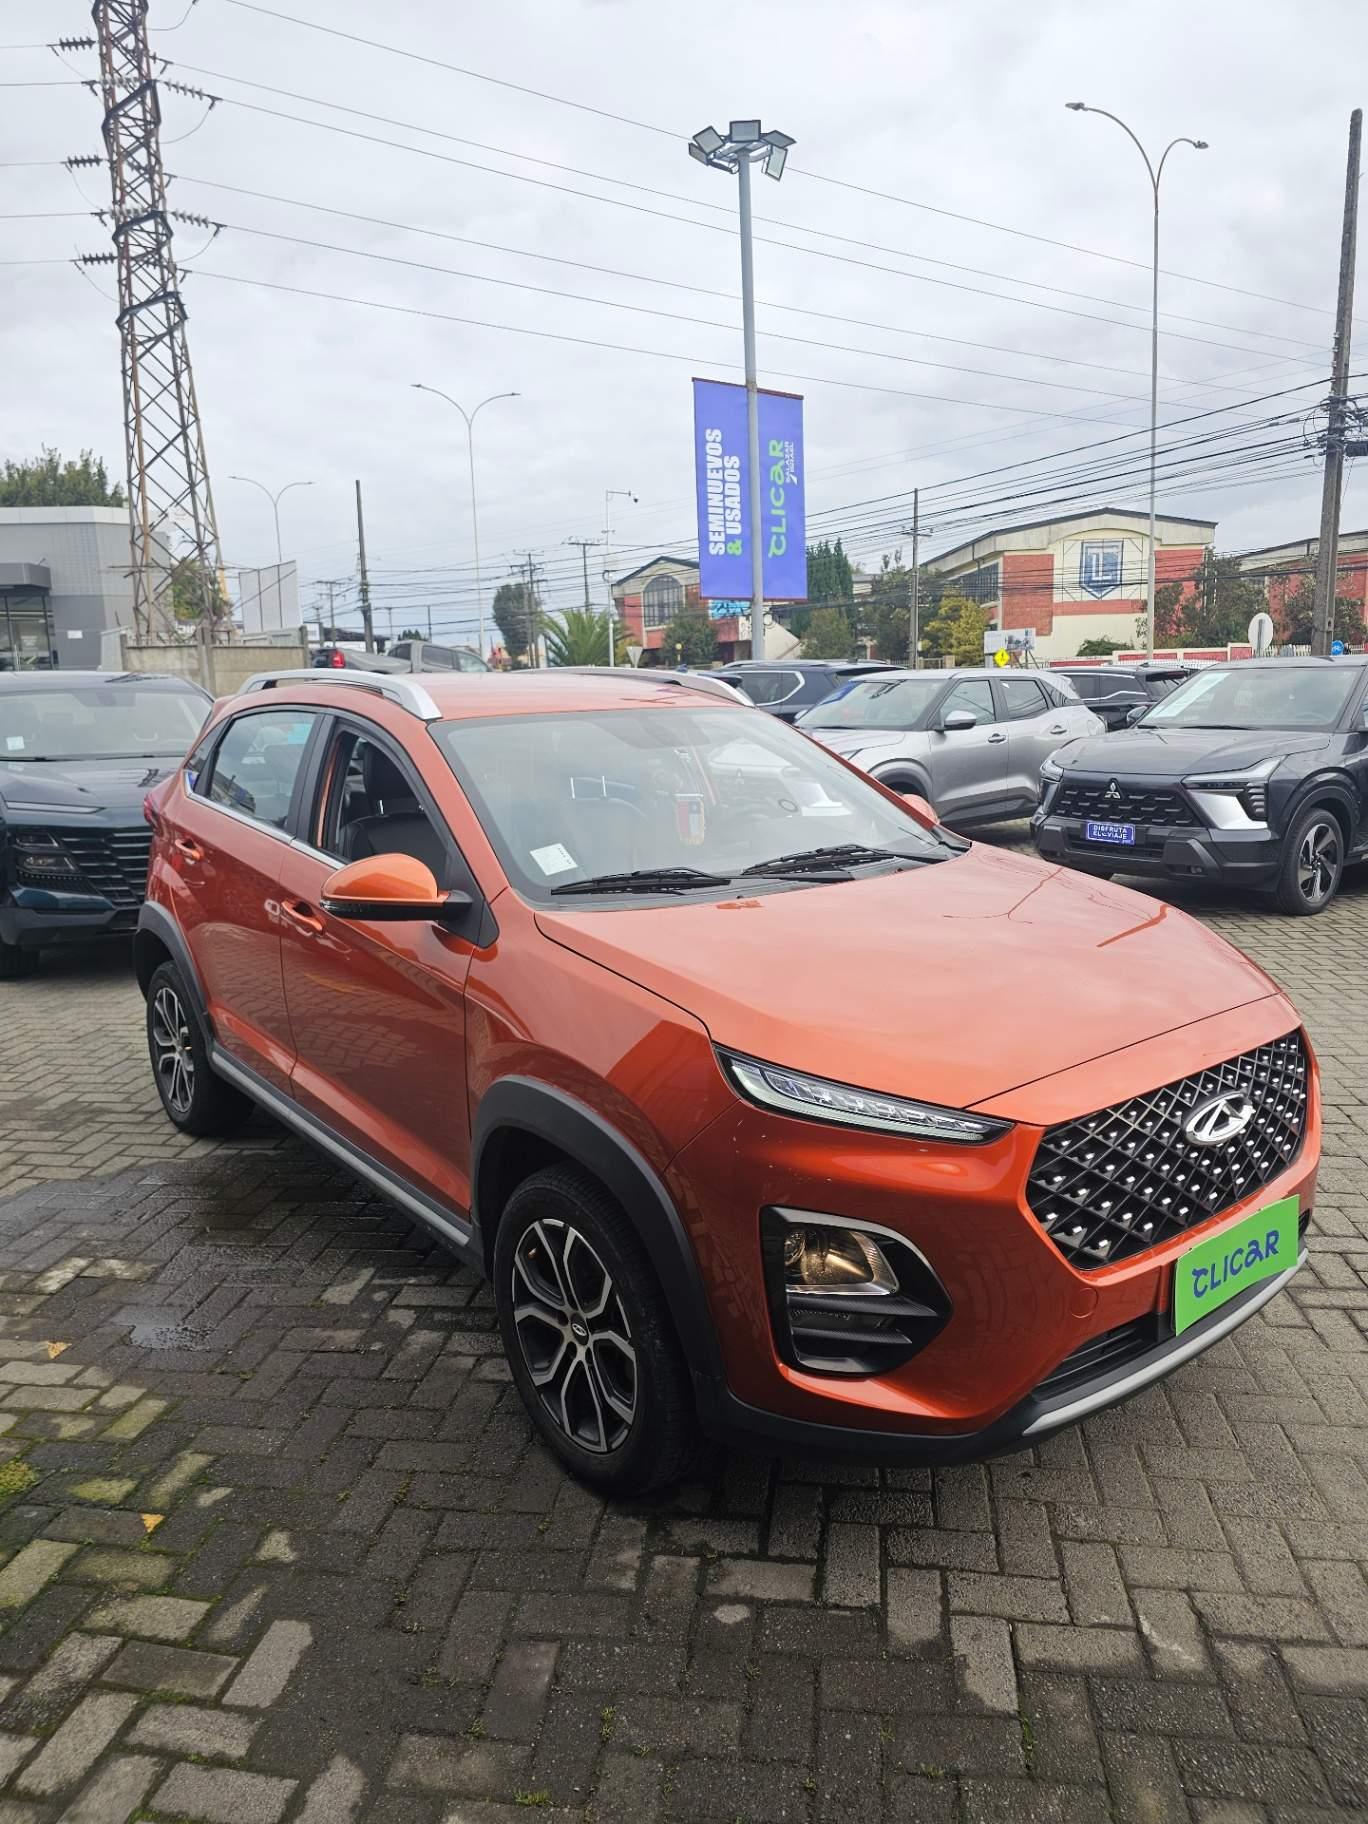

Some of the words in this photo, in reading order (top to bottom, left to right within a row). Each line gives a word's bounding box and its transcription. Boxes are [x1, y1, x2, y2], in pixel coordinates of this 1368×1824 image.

[705, 428, 725, 556] SEMINUEVOS
[724, 455, 741, 535] USADOS
[727, 539, 742, 556] &
[1093, 824, 1127, 833] DISFRUTA
